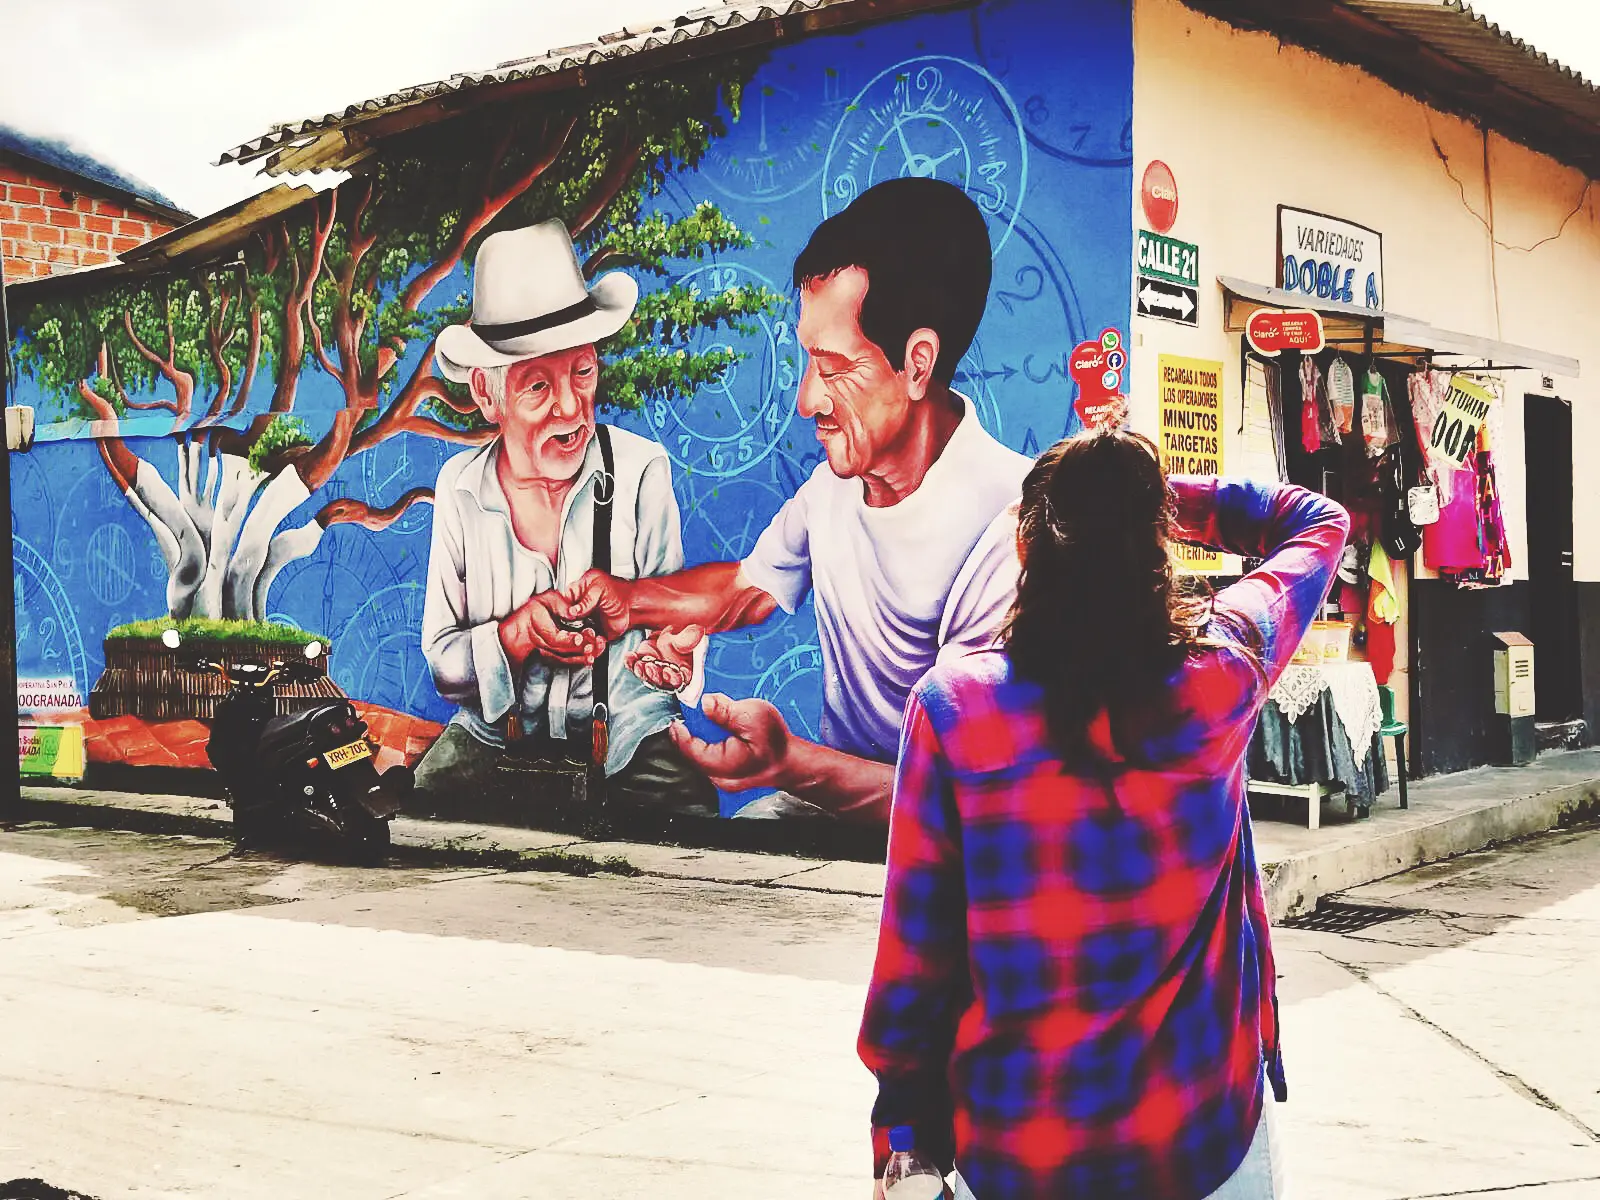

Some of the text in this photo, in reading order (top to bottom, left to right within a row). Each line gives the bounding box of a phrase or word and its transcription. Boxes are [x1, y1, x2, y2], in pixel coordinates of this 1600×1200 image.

[1297, 225, 1364, 263] VARIEDADES
[1138, 236, 1197, 281] CALLE 21
[1284, 254, 1379, 310] DOBLE A
[773, 320, 792, 347] 2
[1253, 328, 1276, 338] Claro
[1075, 357, 1101, 370] Claro
[1163, 366, 1218, 389] RECARGAS A TODOS
[1163, 387, 1218, 409] LOS OPERADORES
[654, 400, 667, 429] 8
[765, 400, 782, 433] 4
[1163, 408, 1218, 432] MINUTOS
[677, 434, 691, 459] 7
[711, 442, 724, 470] 6
[737, 435, 754, 463] 5
[1164, 432, 1218, 455] TARGETAS
[1164, 455, 1218, 477] SIM CARD
[18, 694, 82, 707] OOGRANADA
